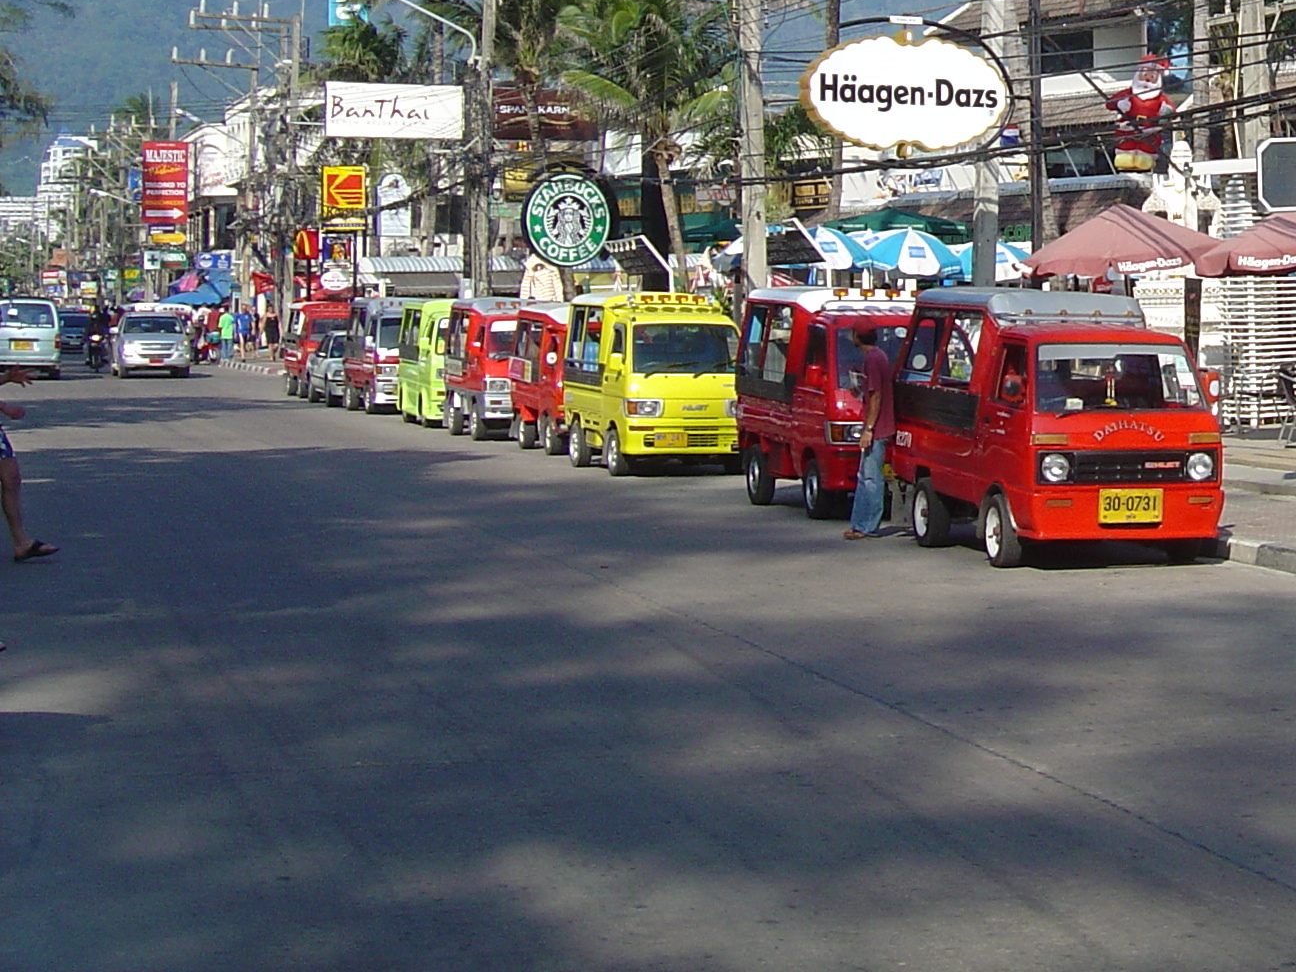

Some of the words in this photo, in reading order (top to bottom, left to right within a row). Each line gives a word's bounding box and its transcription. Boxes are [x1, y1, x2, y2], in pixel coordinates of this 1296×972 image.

[538, 105, 571, 115] KARN
[145, 149, 187, 163] MAJESTIC
[539, 237, 598, 262] COFFEE
[1093, 419, 1166, 442] DAIHATSU
[1103, 495, 1157, 512] 30-0731
